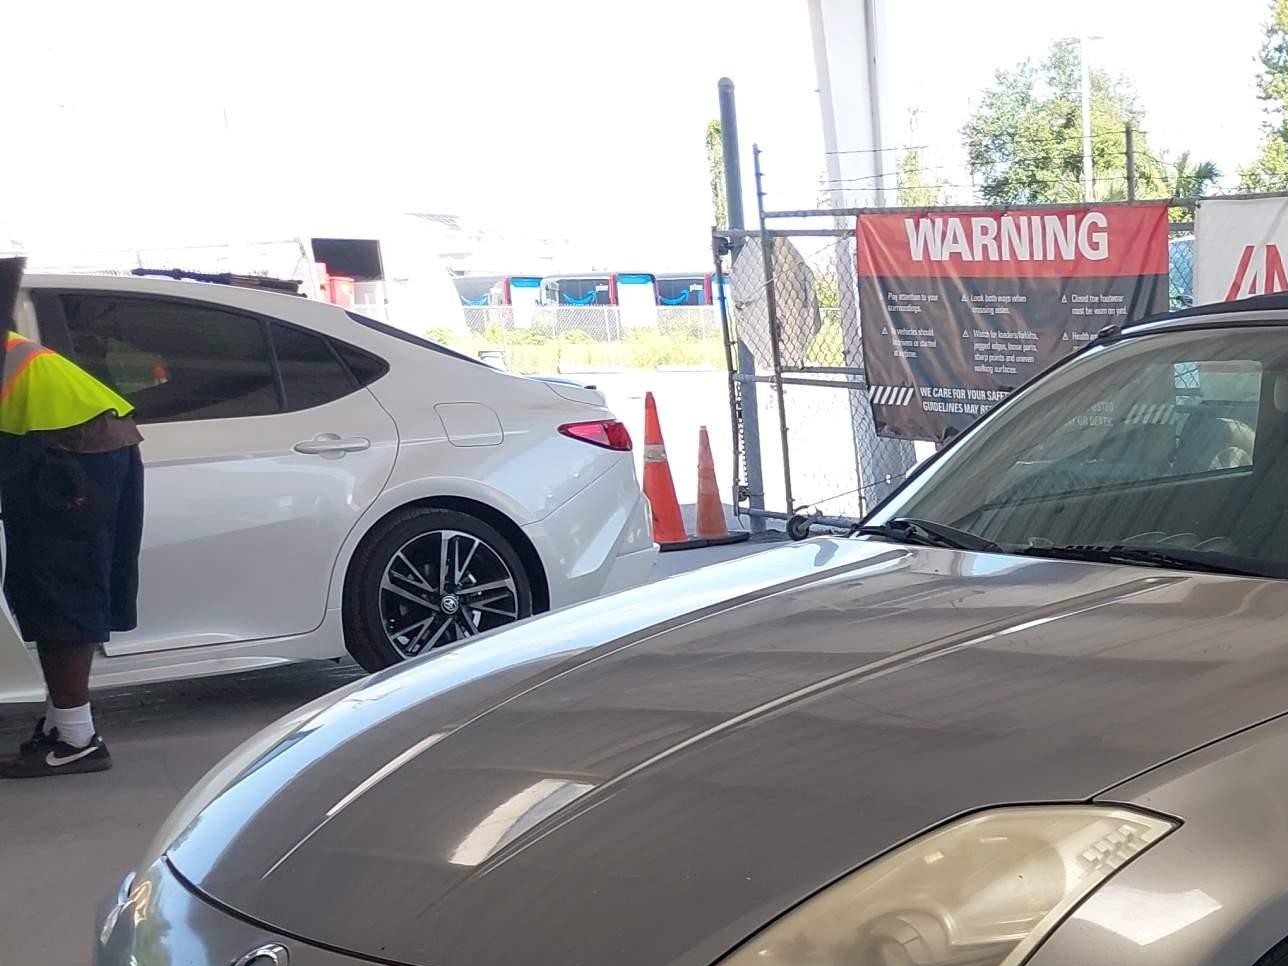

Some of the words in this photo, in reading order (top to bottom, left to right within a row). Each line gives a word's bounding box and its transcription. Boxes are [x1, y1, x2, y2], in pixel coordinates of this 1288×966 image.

[904, 212, 1109, 261] WARNING
[971, 294, 984, 302] Look
[920, 387, 932, 397] WE
[933, 388, 952, 398] CARE
[953, 389, 965, 399] FOR
[967, 390, 986, 400] YOUR
[923, 401, 963, 413] GUIDELINES
[964, 403, 979, 414] MAY
